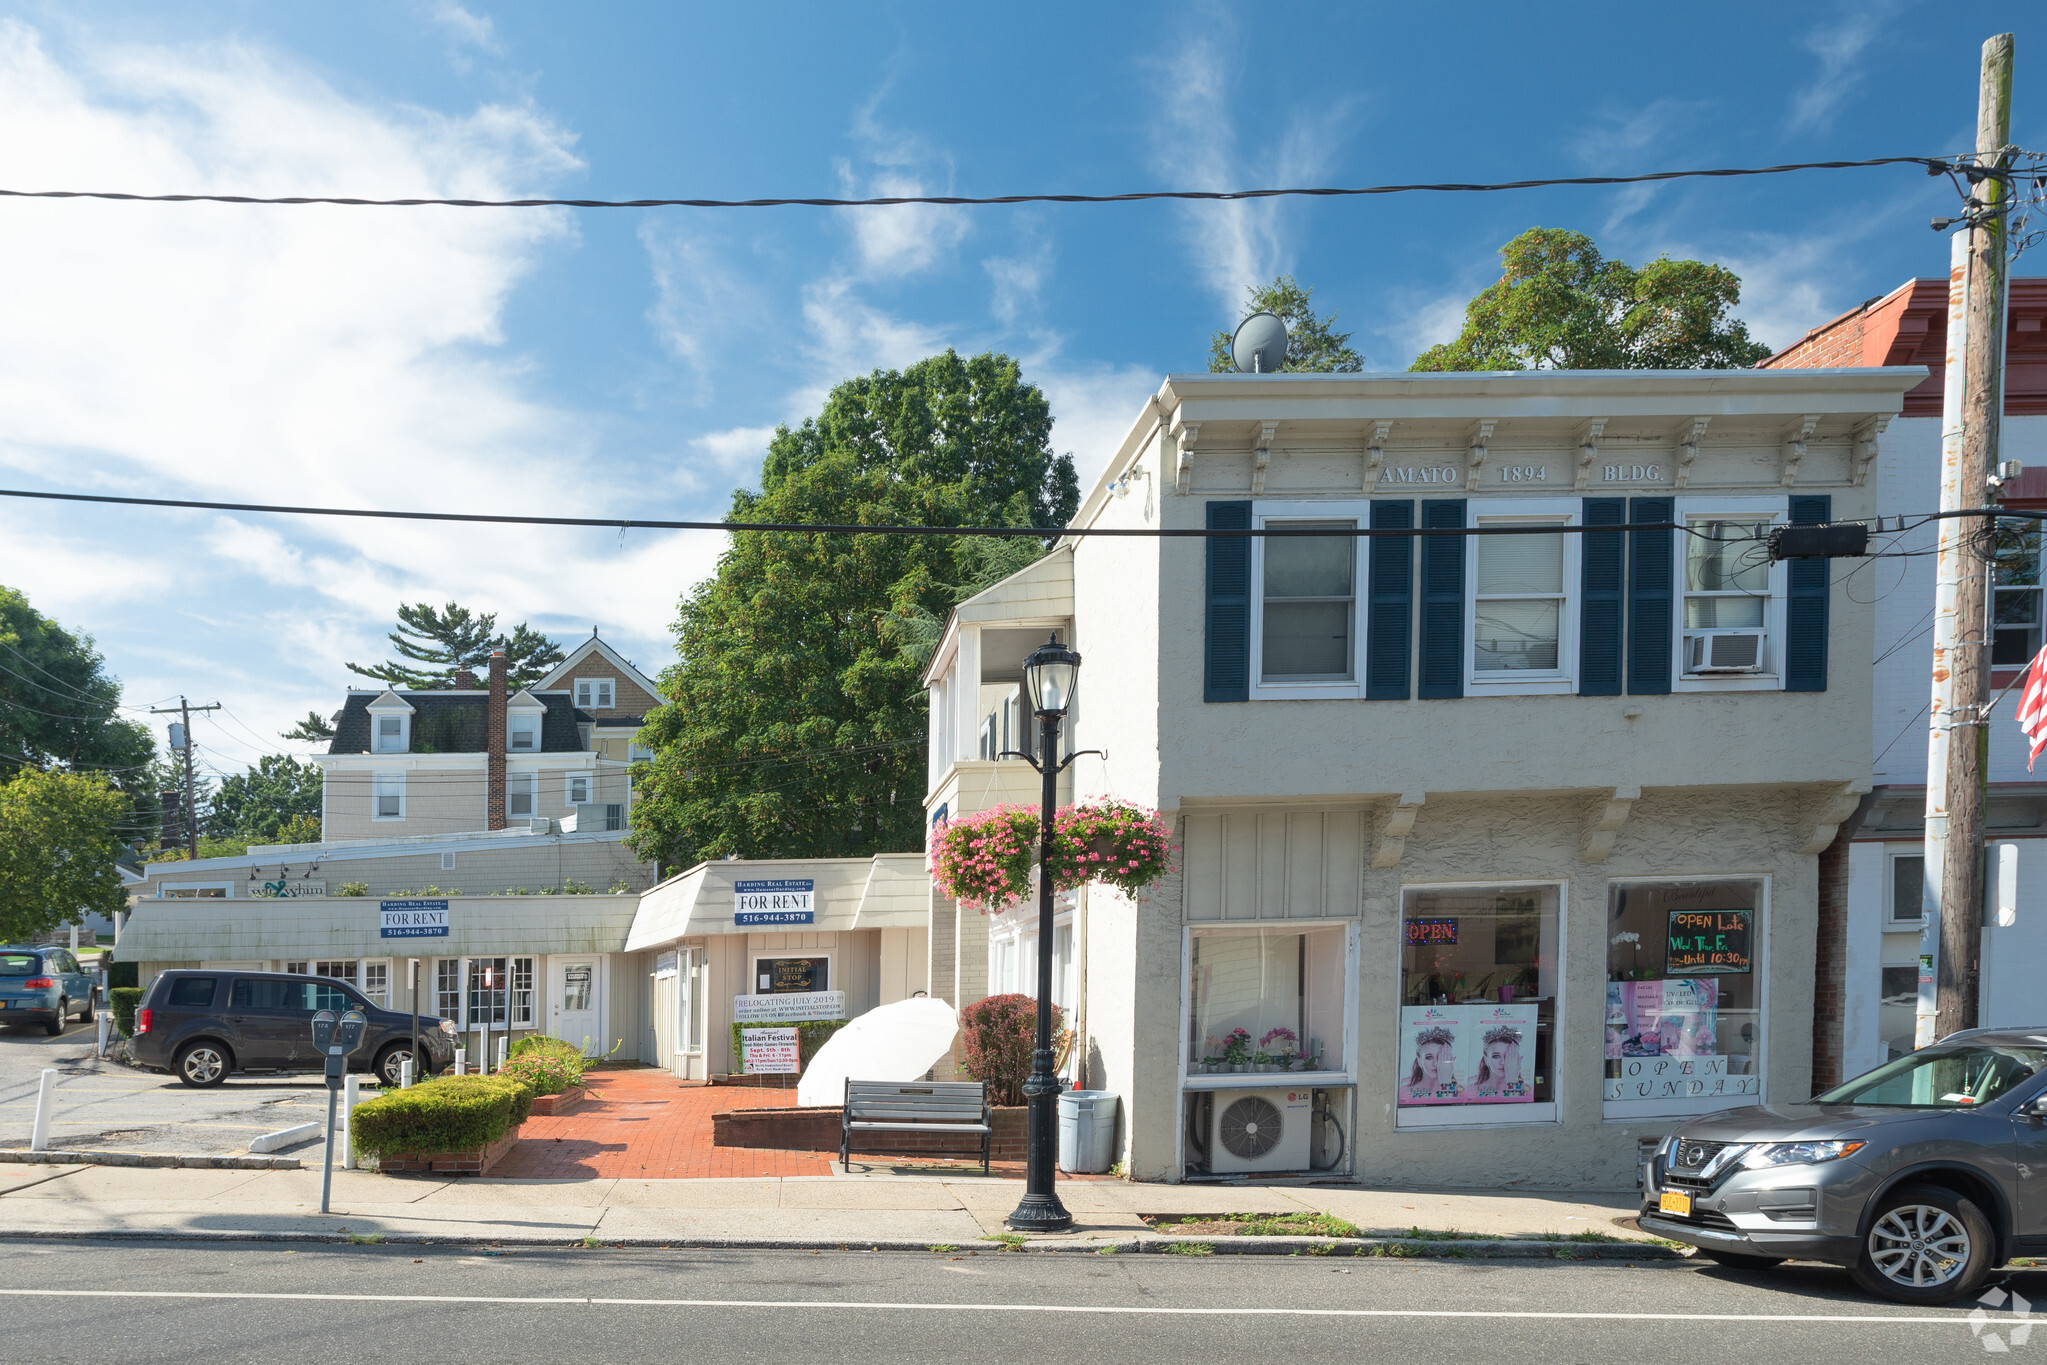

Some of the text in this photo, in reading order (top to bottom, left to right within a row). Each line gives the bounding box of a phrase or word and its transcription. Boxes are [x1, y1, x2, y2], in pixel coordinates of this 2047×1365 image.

[1379, 465, 1664, 483] AMATO 1894 BLDG.
[284, 883, 323, 897] whim
[785, 879, 806, 887] ESTATE
[740, 894, 809, 910] FOR RENT
[385, 912, 445, 926] FOR RENT
[742, 913, 807, 923] 516-944-3870
[1677, 914, 1744, 931] OPEN Late
[387, 928, 443, 936] 516-944-3870
[1408, 923, 1454, 940] OPEN
[778, 966, 807, 974] INITIAL
[782, 974, 803, 982] STOP
[738, 995, 834, 1007] RELOCATING JULY 2019
[1628, 1059, 1725, 1077] OPEN
[1611, 1078, 1754, 1099] SUNDAY
